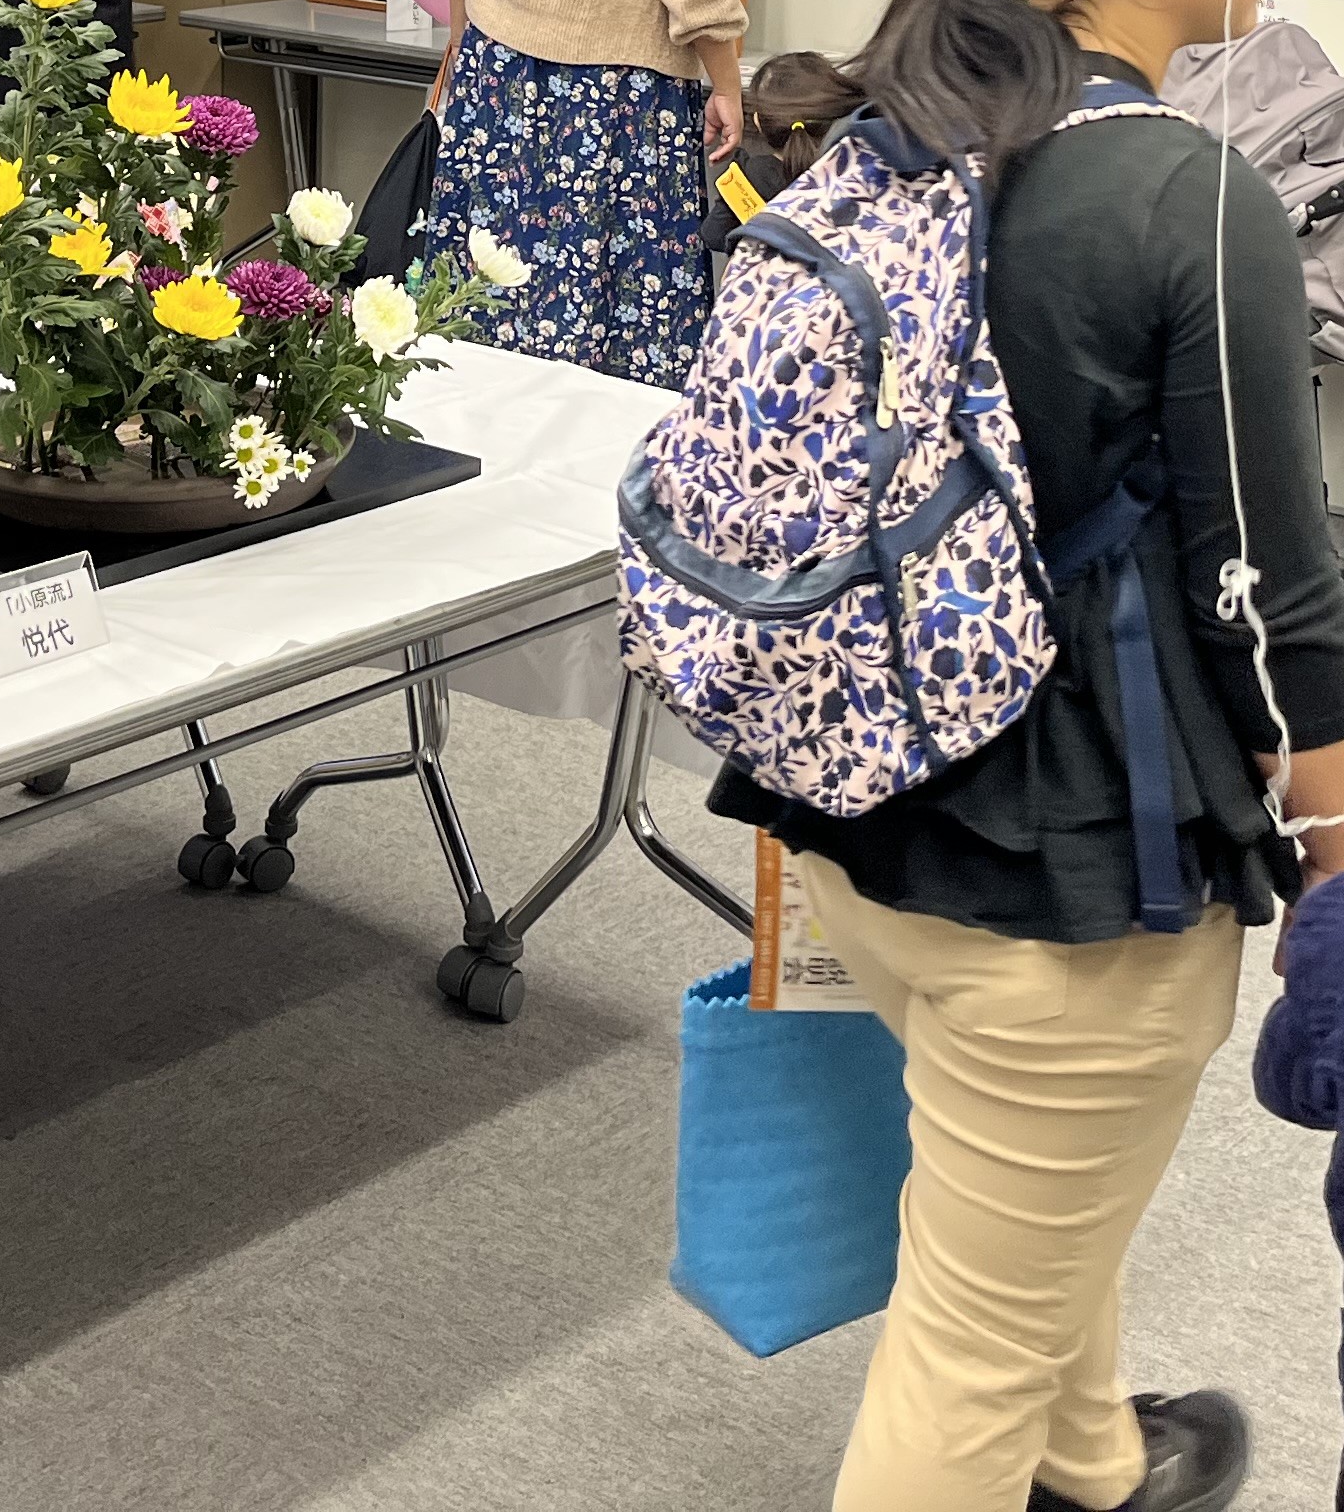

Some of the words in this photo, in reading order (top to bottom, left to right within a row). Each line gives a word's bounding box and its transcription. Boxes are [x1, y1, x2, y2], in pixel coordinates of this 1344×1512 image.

[6, 579, 74, 617] 「小原流」
[22, 618, 74, 658] 悦代
